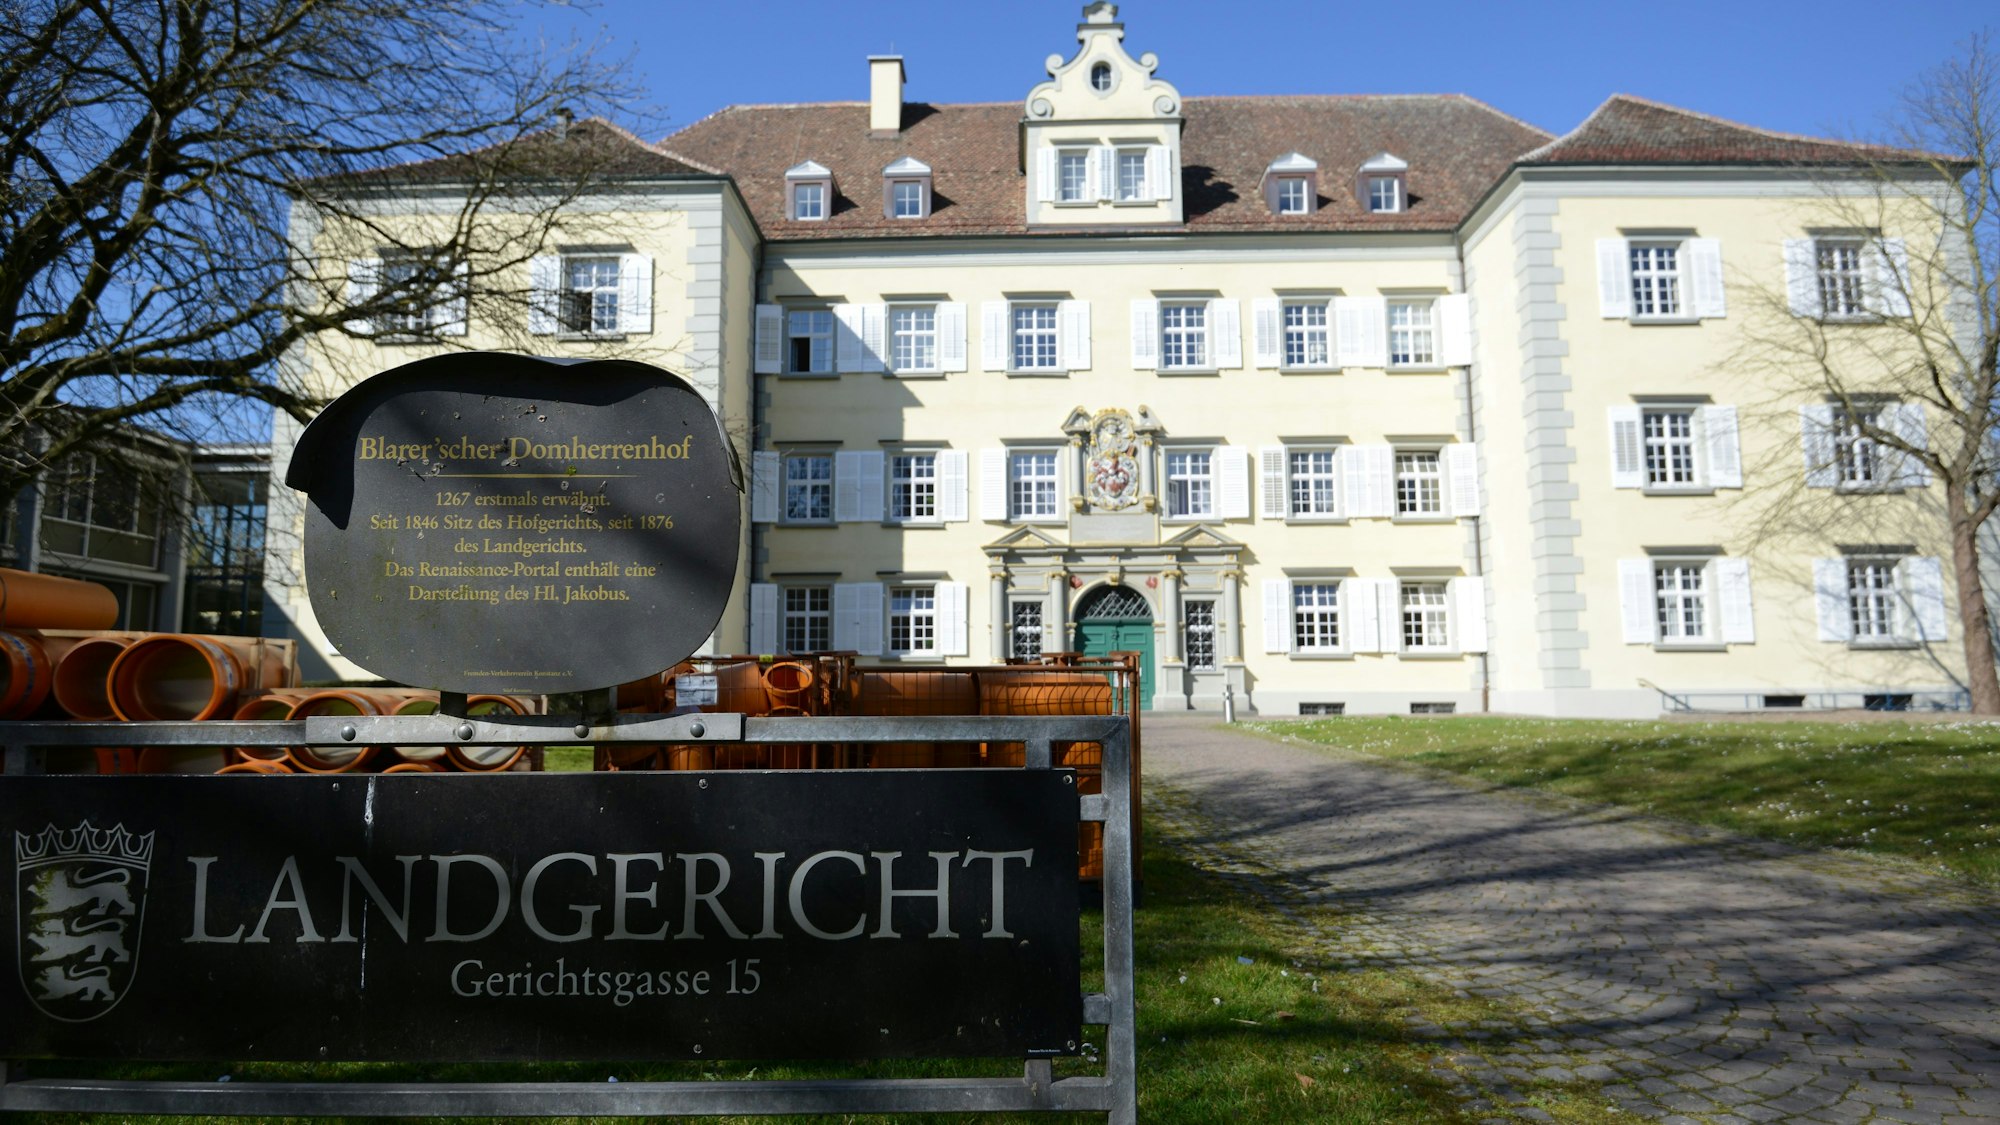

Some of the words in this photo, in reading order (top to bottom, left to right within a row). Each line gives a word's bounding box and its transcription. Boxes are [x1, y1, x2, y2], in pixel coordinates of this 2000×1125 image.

[509, 435, 693, 460] Domherrenhof
[436, 491, 471, 506] 1267
[475, 490, 538, 506] erstmals
[542, 490, 611, 506] erwähnt.
[370, 514, 399, 530] Seit
[405, 514, 439, 530] 1846
[443, 514, 473, 530] Sitz
[478, 513, 503, 530] des
[507, 513, 603, 534] Hofgerichts,
[608, 514, 634, 530] seit
[640, 515, 674, 530] 1876
[454, 537, 479, 553] des
[483, 537, 587, 558] Landgerichts.
[384, 561, 414, 577] Das
[419, 560, 560, 577] Renaissance-Portal
[565, 561, 620, 577] enthält
[625, 561, 656, 577] eine
[504, 584, 529, 601] des
[533, 584, 559, 601] Hl.
[563, 584, 630, 605] Jakobus.
[180, 848, 1034, 945] LANDGERICHT
[450, 957, 711, 1007] Gerichtsgasse
[725, 958, 762, 995] 15
